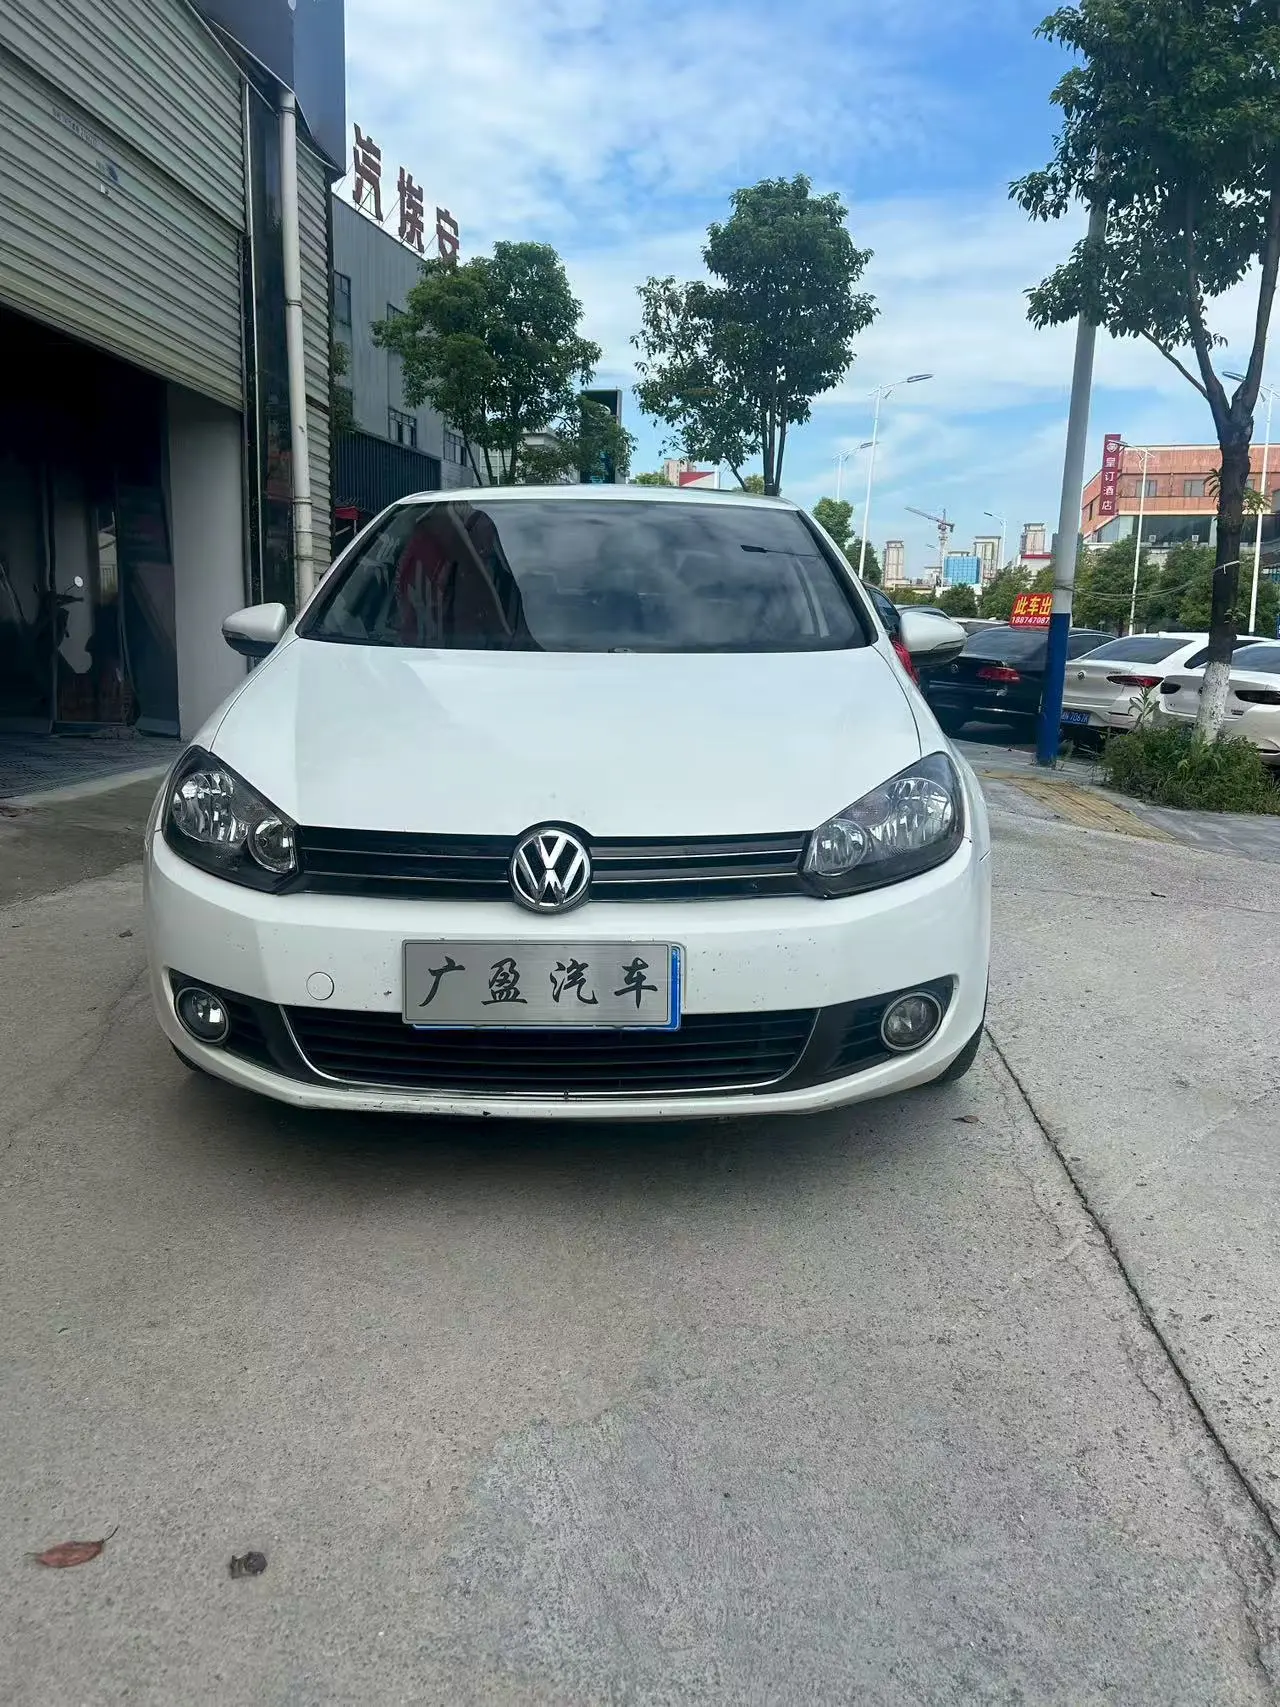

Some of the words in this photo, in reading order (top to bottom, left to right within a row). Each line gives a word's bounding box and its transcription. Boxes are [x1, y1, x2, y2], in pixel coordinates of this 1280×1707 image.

[1014, 596, 1052, 615] 此车出
[418, 956, 658, 1009] 广盈汽车
